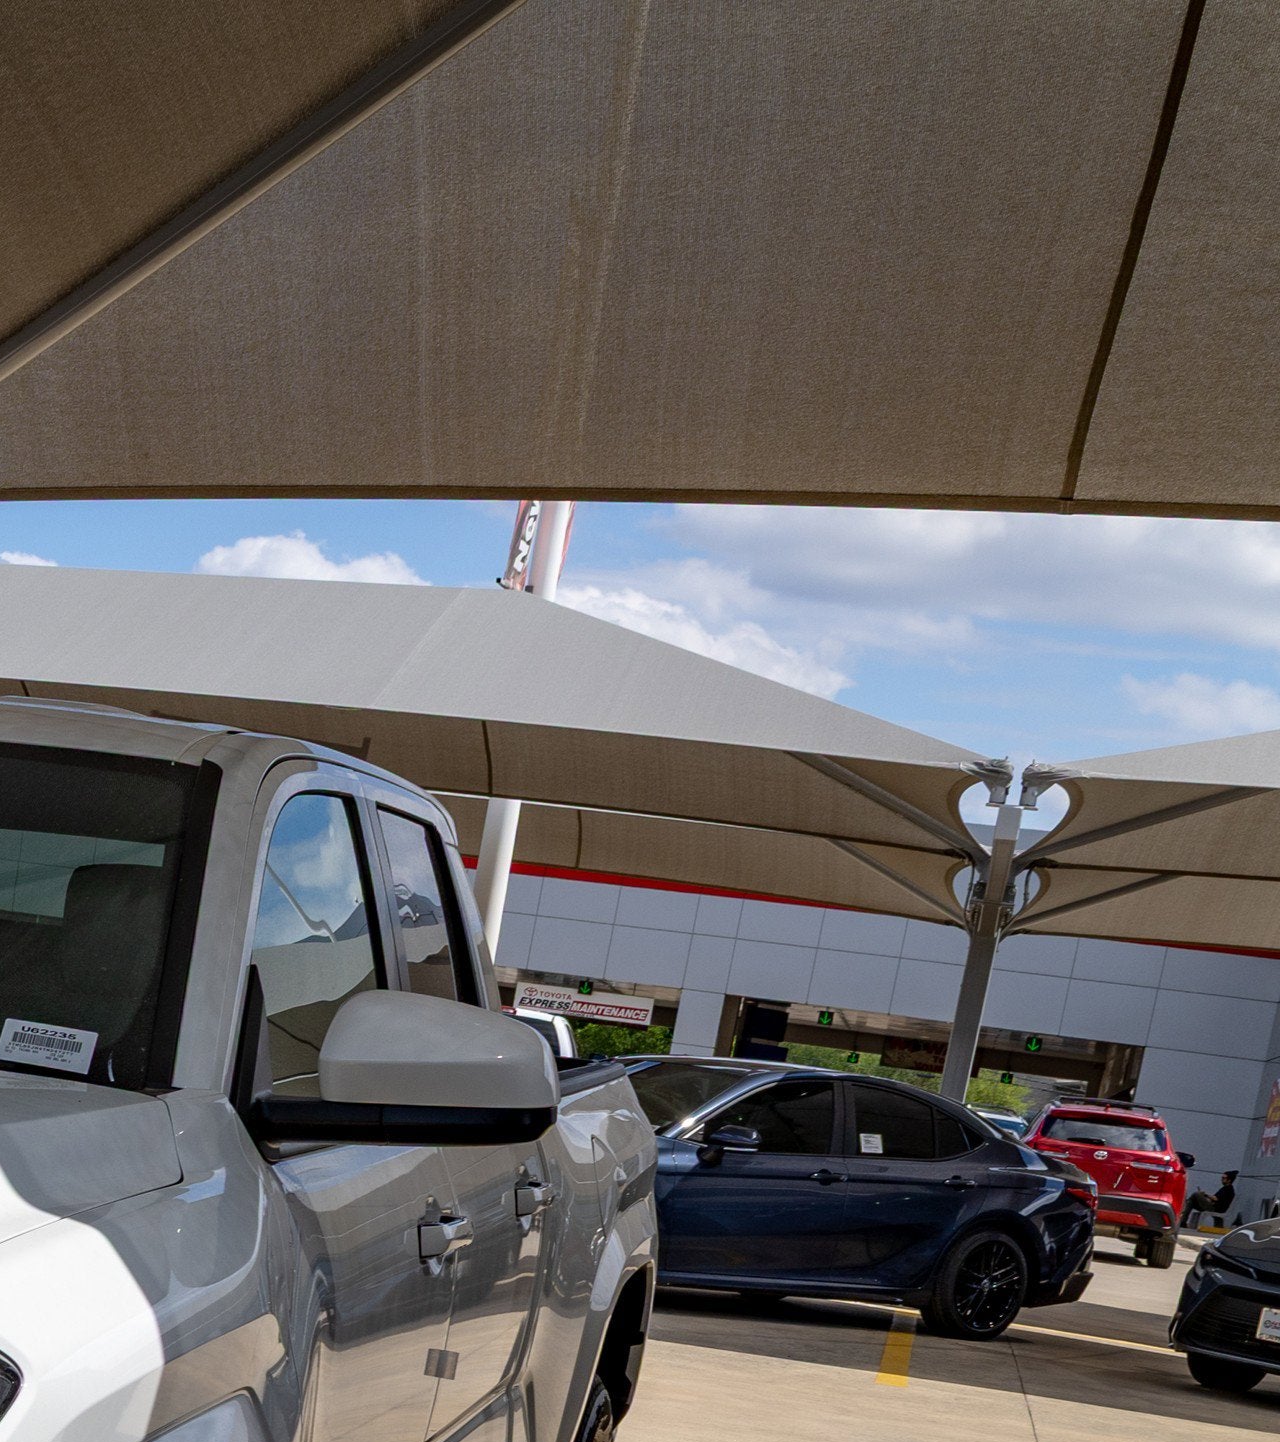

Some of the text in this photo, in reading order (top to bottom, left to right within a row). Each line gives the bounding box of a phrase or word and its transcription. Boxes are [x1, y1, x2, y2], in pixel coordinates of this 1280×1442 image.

[539, 990, 572, 1000] TOYOTA
[518, 997, 571, 1010] EXPRESS
[570, 1002, 649, 1021] MAINTENANCE
